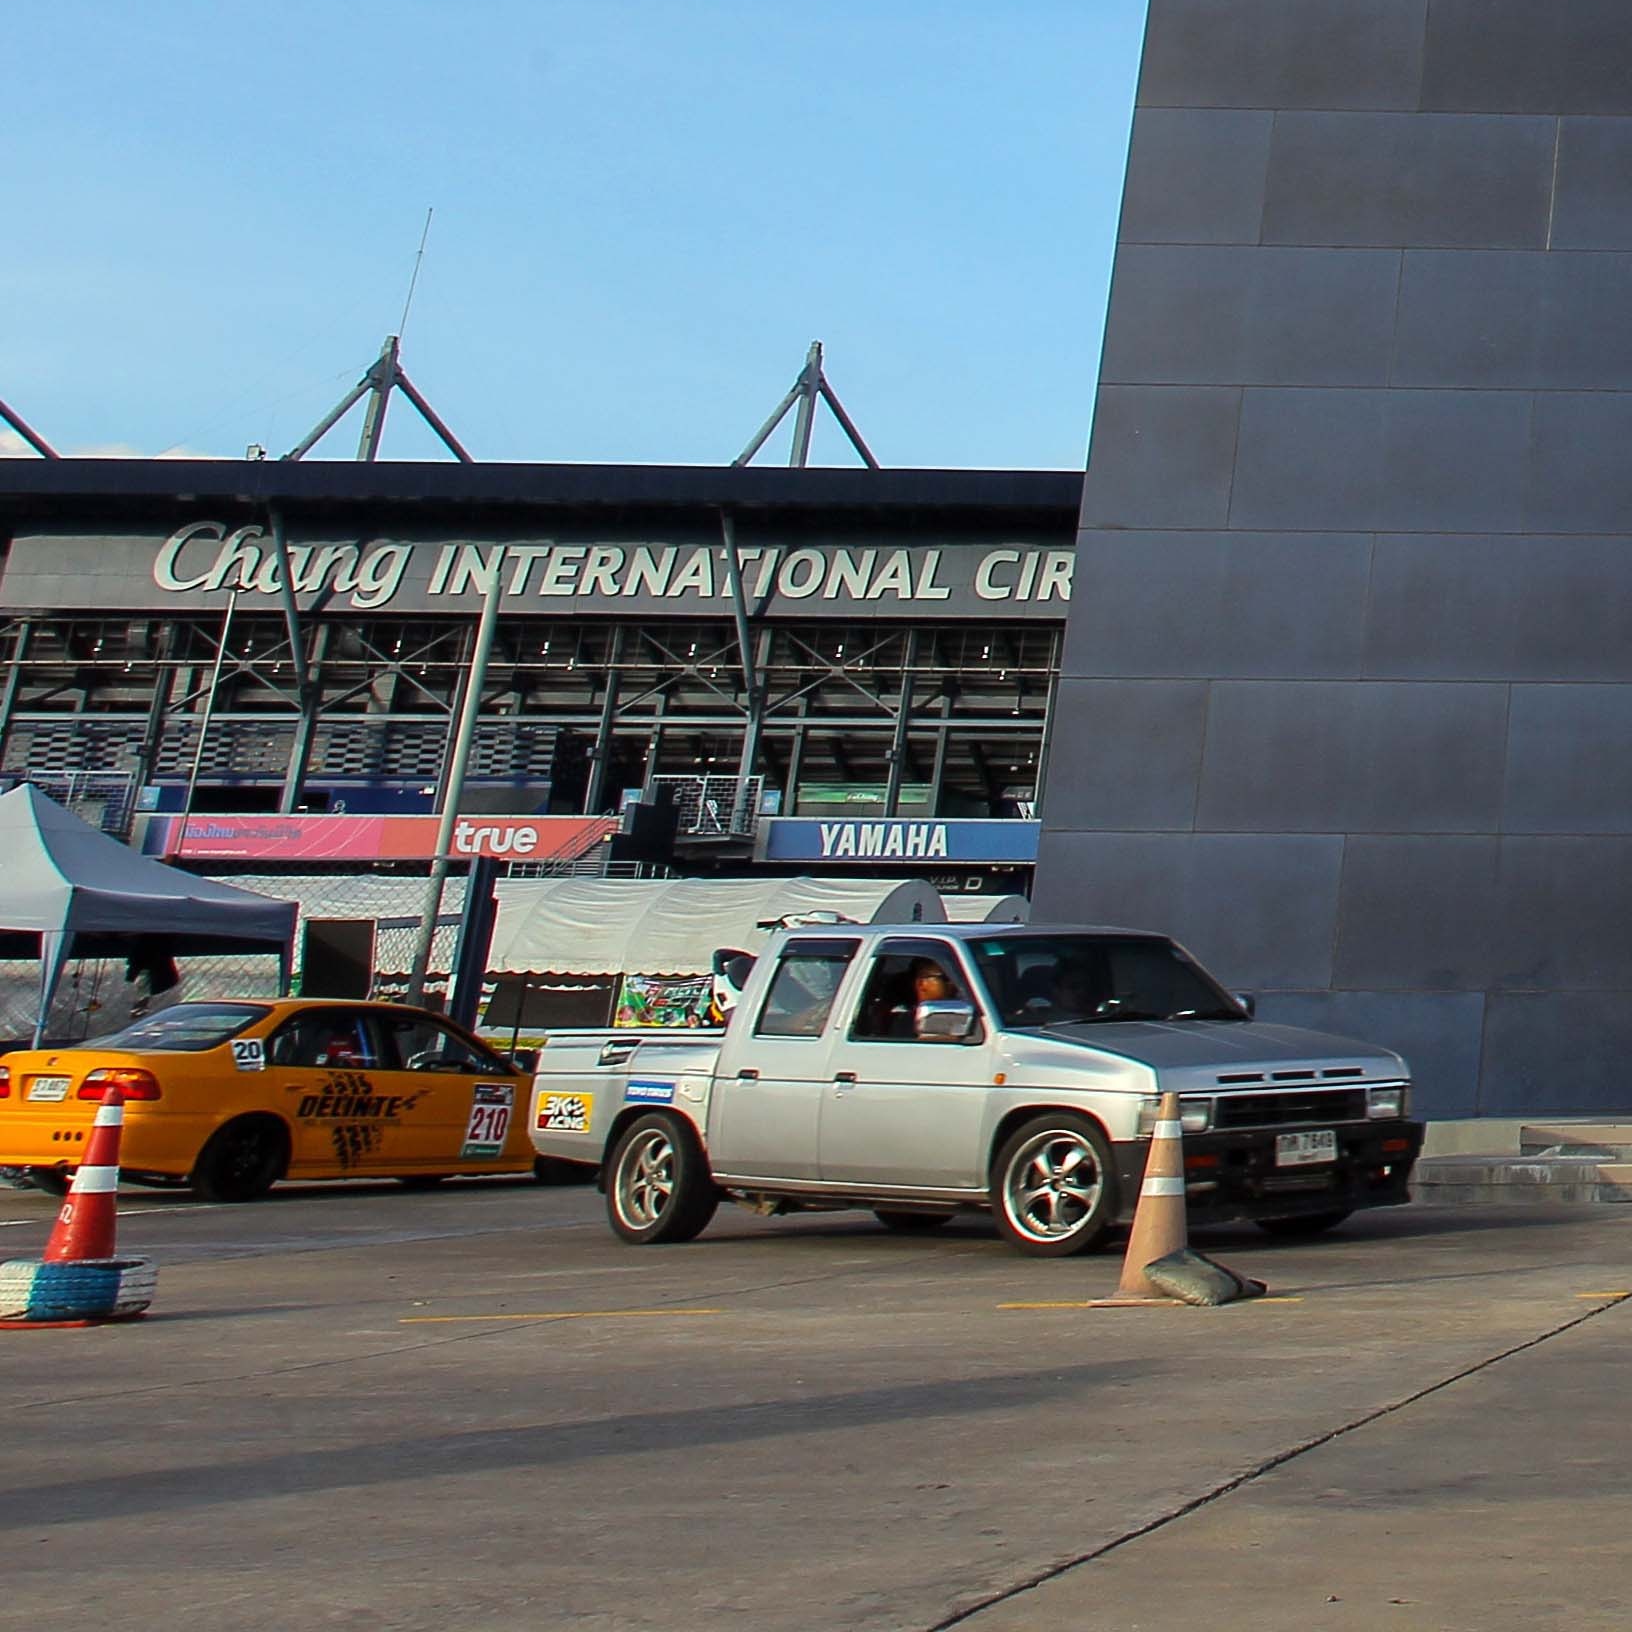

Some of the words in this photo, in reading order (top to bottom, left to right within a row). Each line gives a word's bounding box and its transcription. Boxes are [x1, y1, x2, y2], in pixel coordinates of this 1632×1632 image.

[154, 521, 415, 608] Chang
[427, 544, 951, 601] INTERNATIONAL
[974, 550, 1077, 602] CIR
[454, 821, 538, 854] true
[820, 823, 948, 857] YAMAHA
[234, 1041, 261, 1060] 20
[298, 1095, 403, 1118] DELINTE
[469, 1107, 509, 1141] 210
